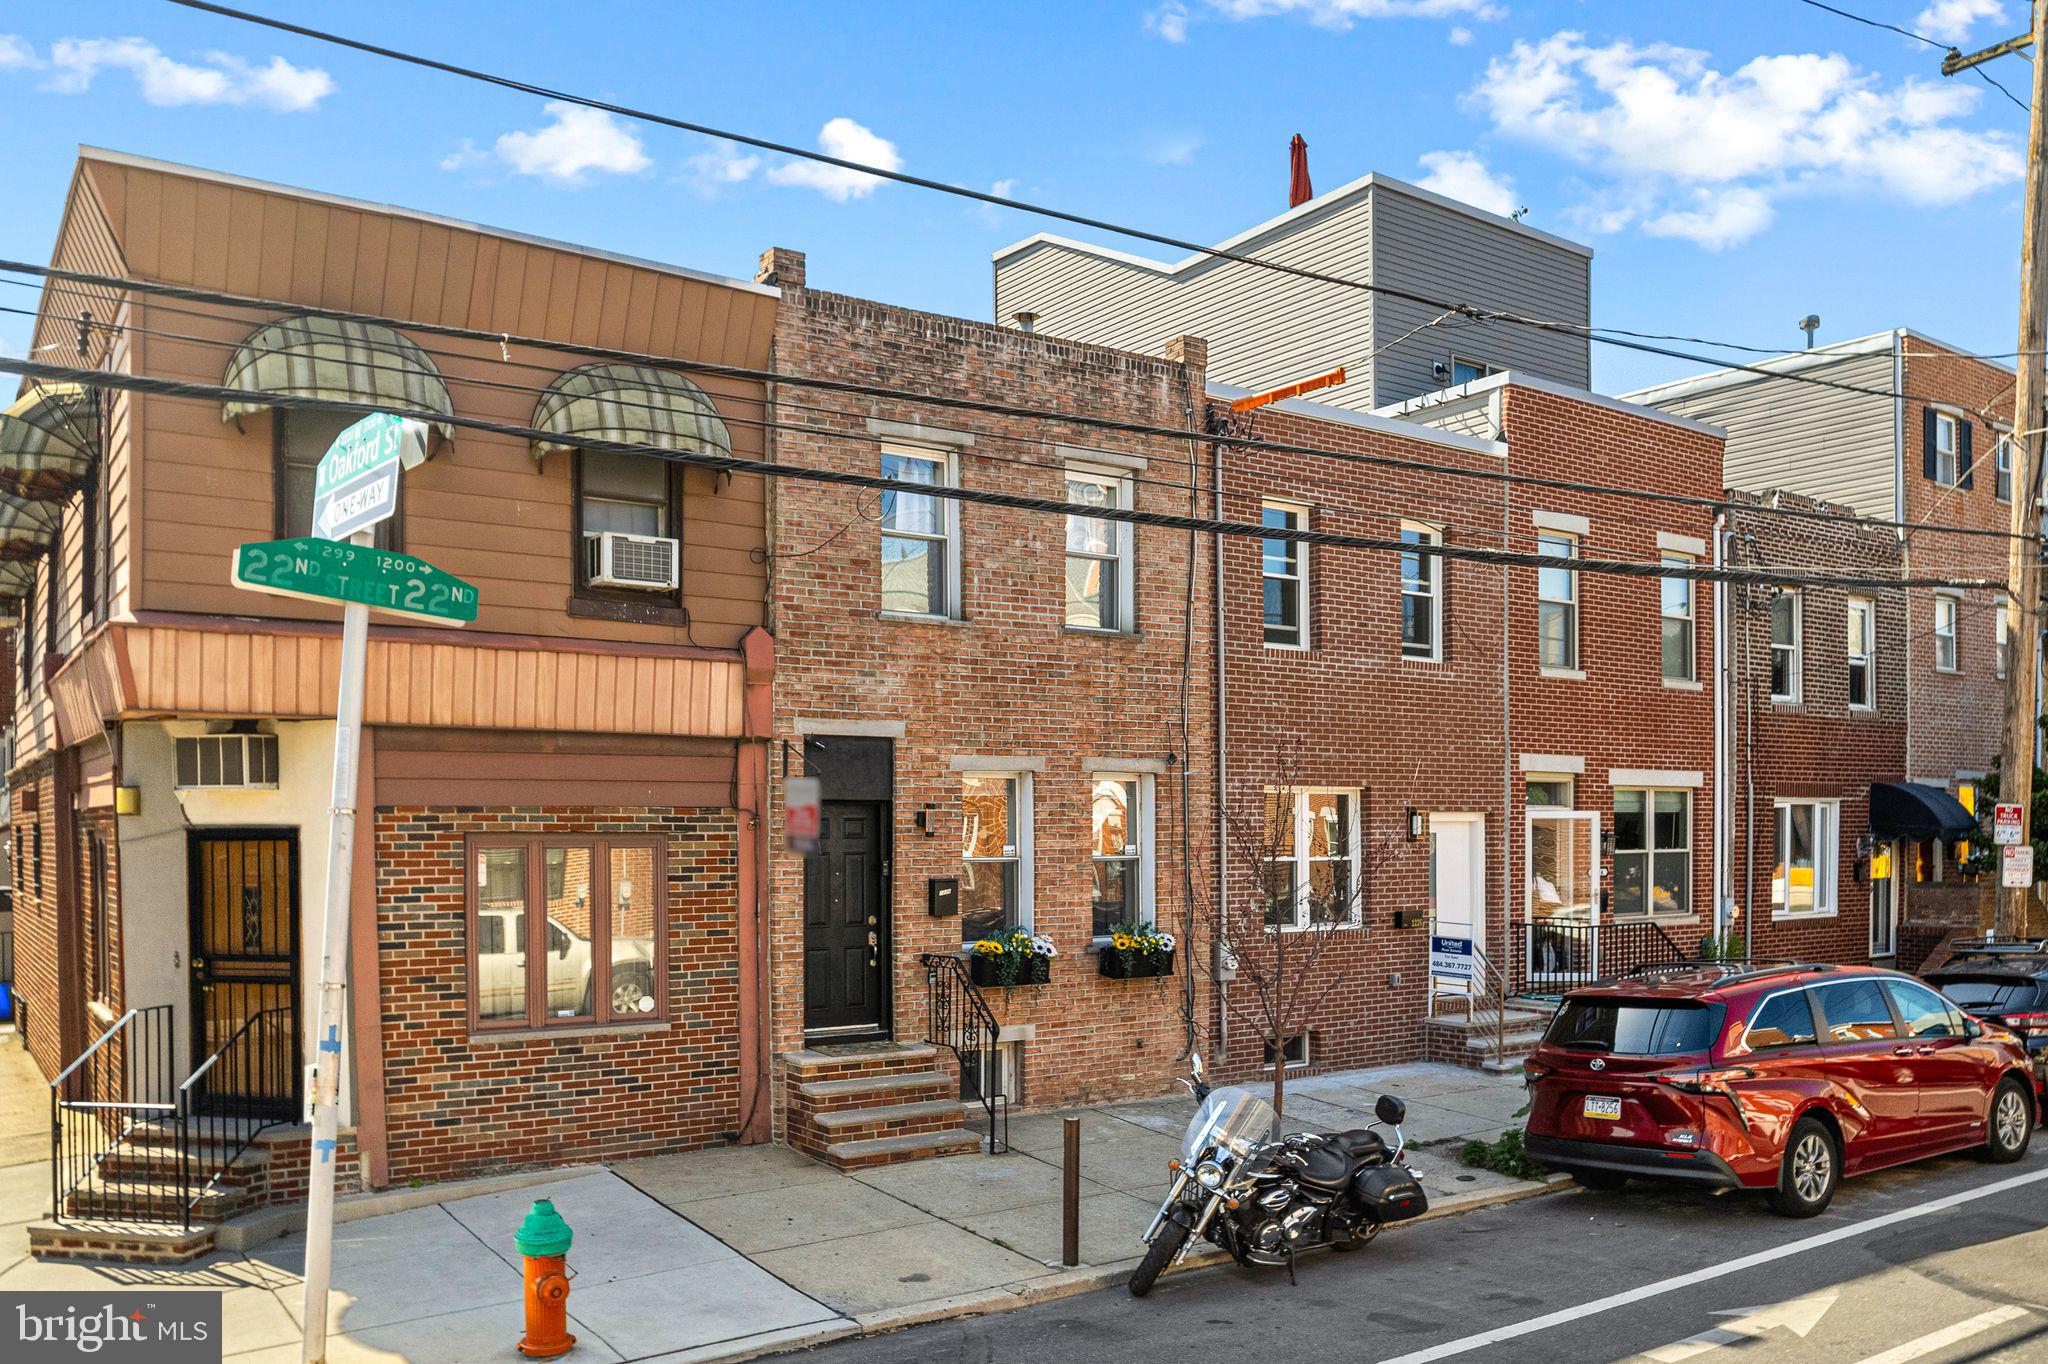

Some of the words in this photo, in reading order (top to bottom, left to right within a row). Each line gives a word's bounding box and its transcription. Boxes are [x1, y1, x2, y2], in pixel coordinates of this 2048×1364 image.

[328, 431, 381, 484] Oakford
[335, 495, 356, 522] ONE
[360, 480, 385, 510] WAY
[244, 548, 320, 587] 22ND
[404, 579, 474, 614] 22ND
[377, 556, 415, 573] 1200
[1441, 939, 1463, 948] United
